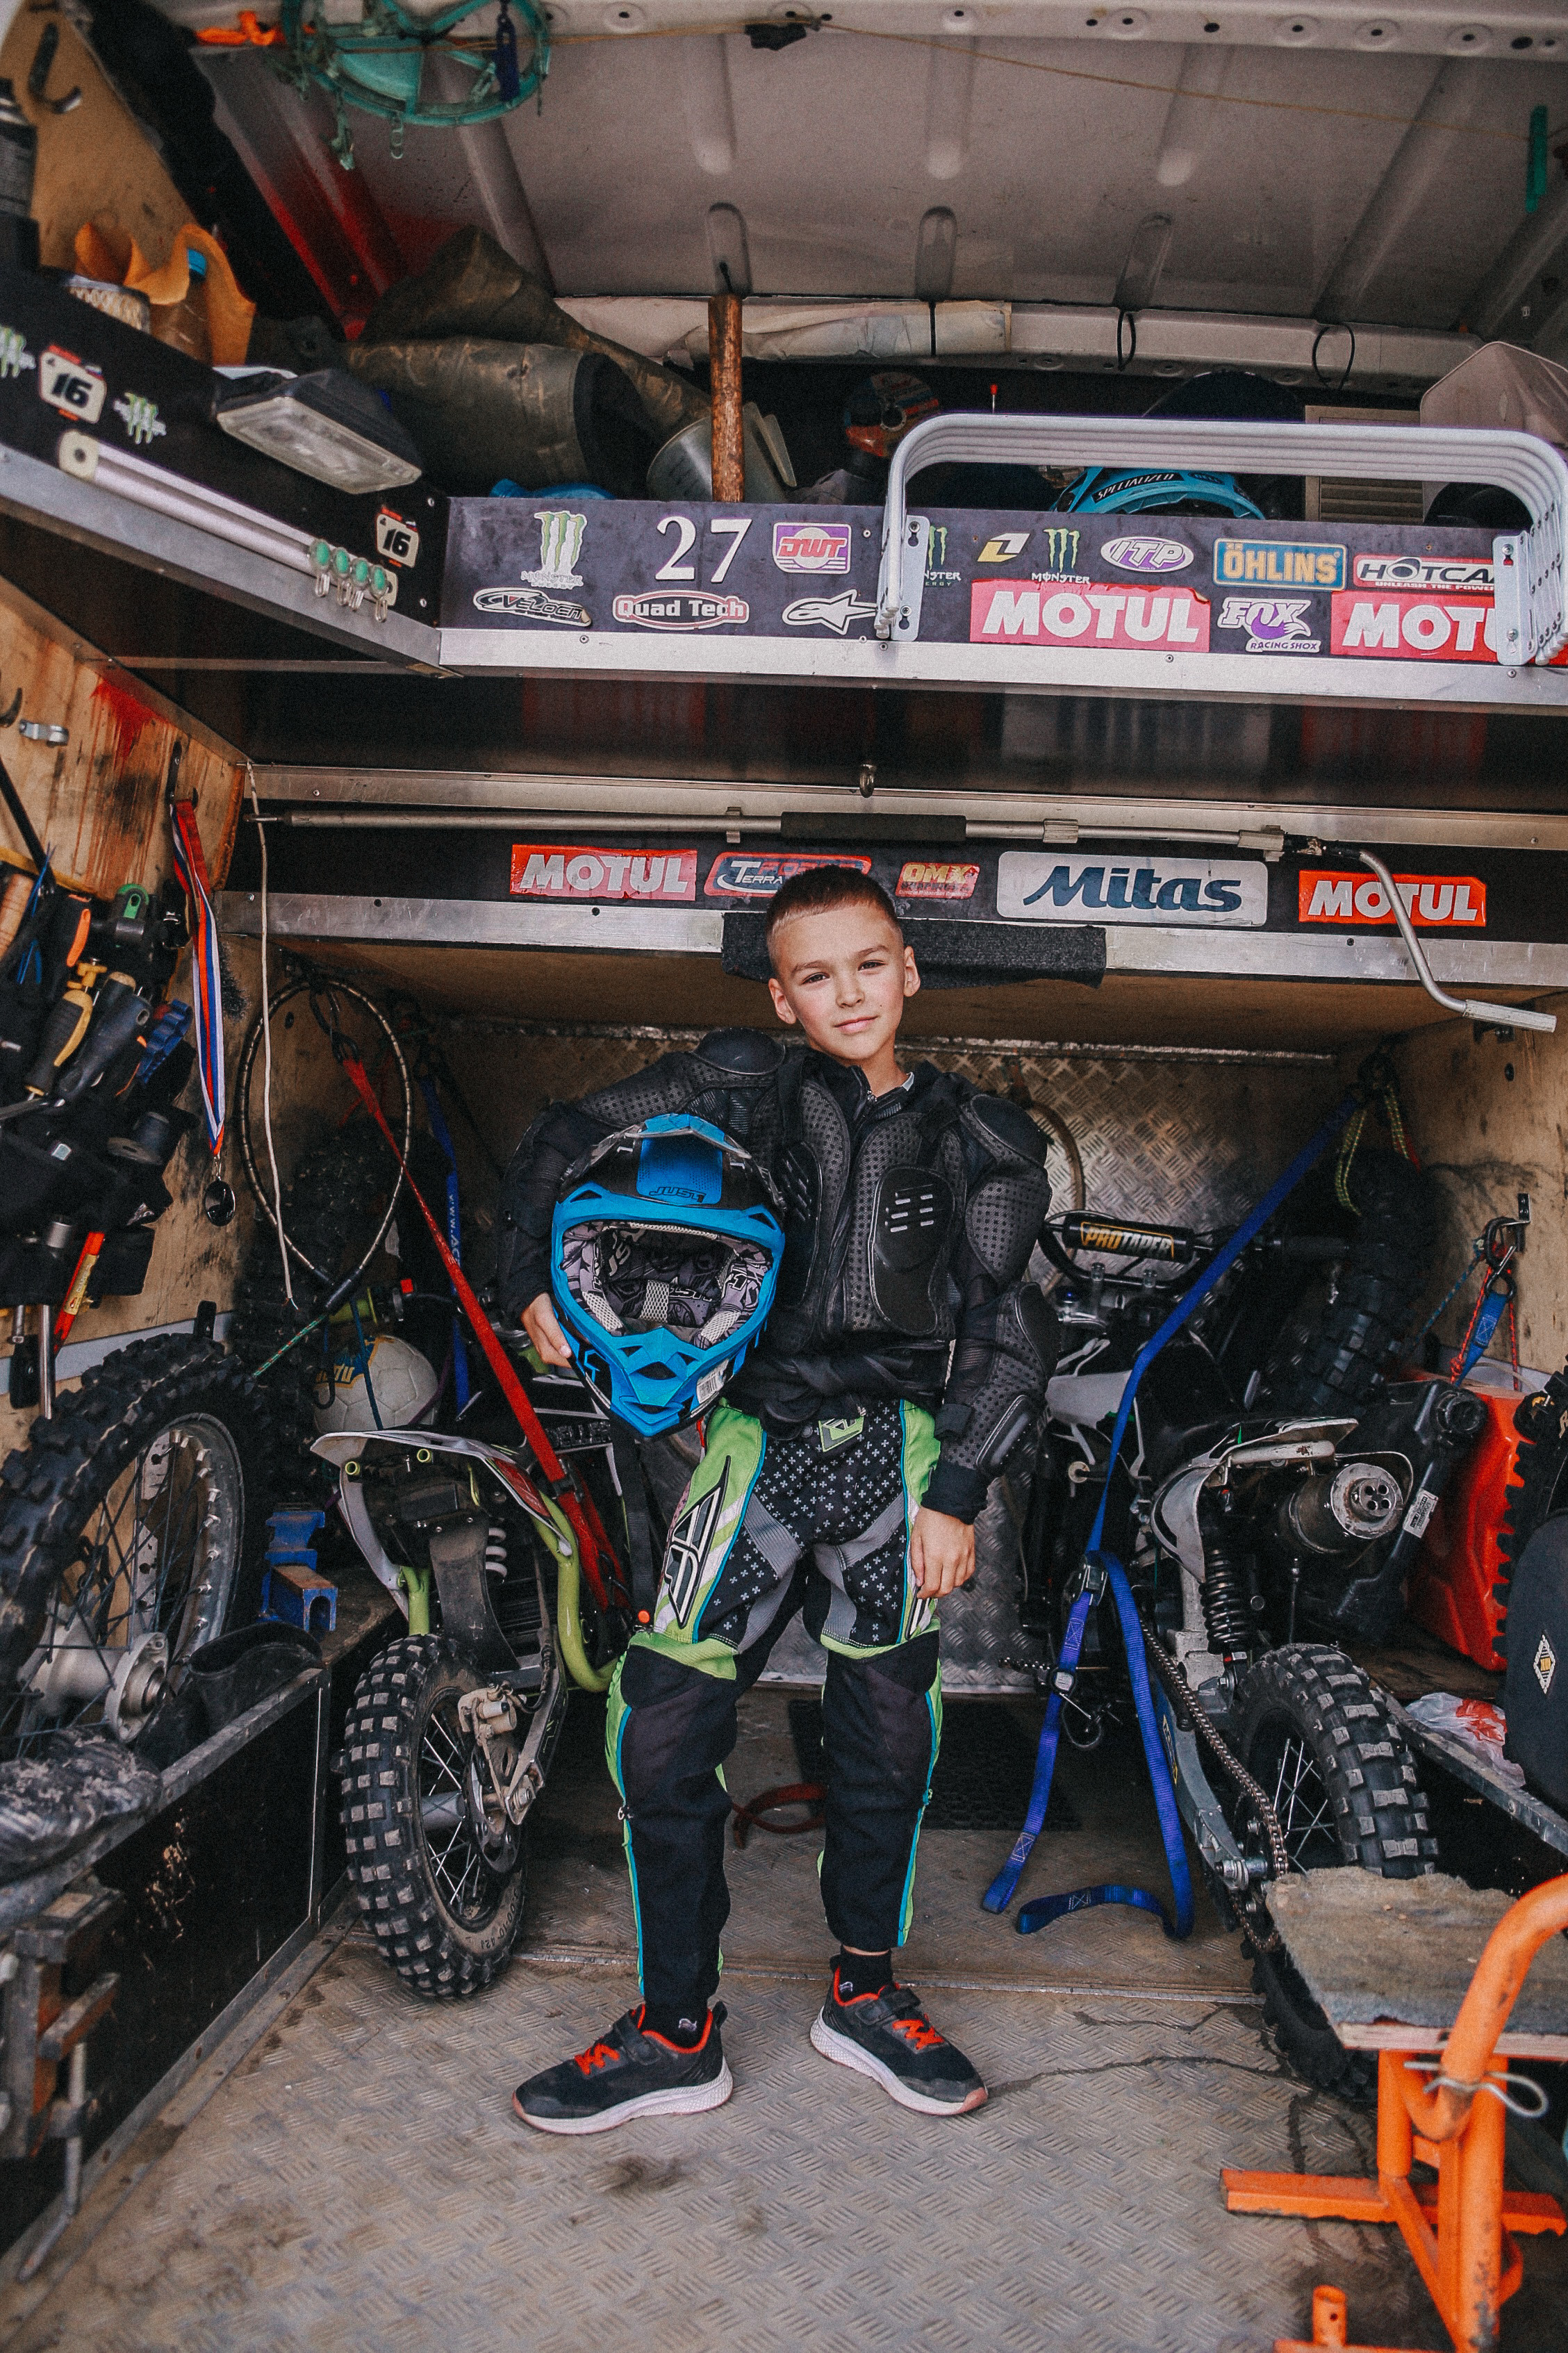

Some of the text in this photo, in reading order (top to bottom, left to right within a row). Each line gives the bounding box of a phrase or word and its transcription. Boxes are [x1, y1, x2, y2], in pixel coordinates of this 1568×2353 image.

[52, 373, 93, 409] 16
[382, 528, 412, 558] 16
[779, 538, 846, 558] DWT
[1110, 540, 1184, 566] ITP
[1031, 572, 1091, 584] MONSTER
[1360, 558, 1494, 584] HOTCA
[618, 599, 744, 618] Quad Tech
[981, 590, 1200, 643] MOTUL
[1223, 600, 1304, 627] FOX
[1251, 641, 1318, 651] RACING SHOX
[519, 853, 690, 894] MOTUL
[903, 864, 973, 884] OMX
[1023, 865, 1243, 912] Mitas
[1307, 880, 1478, 921] MOTUL
